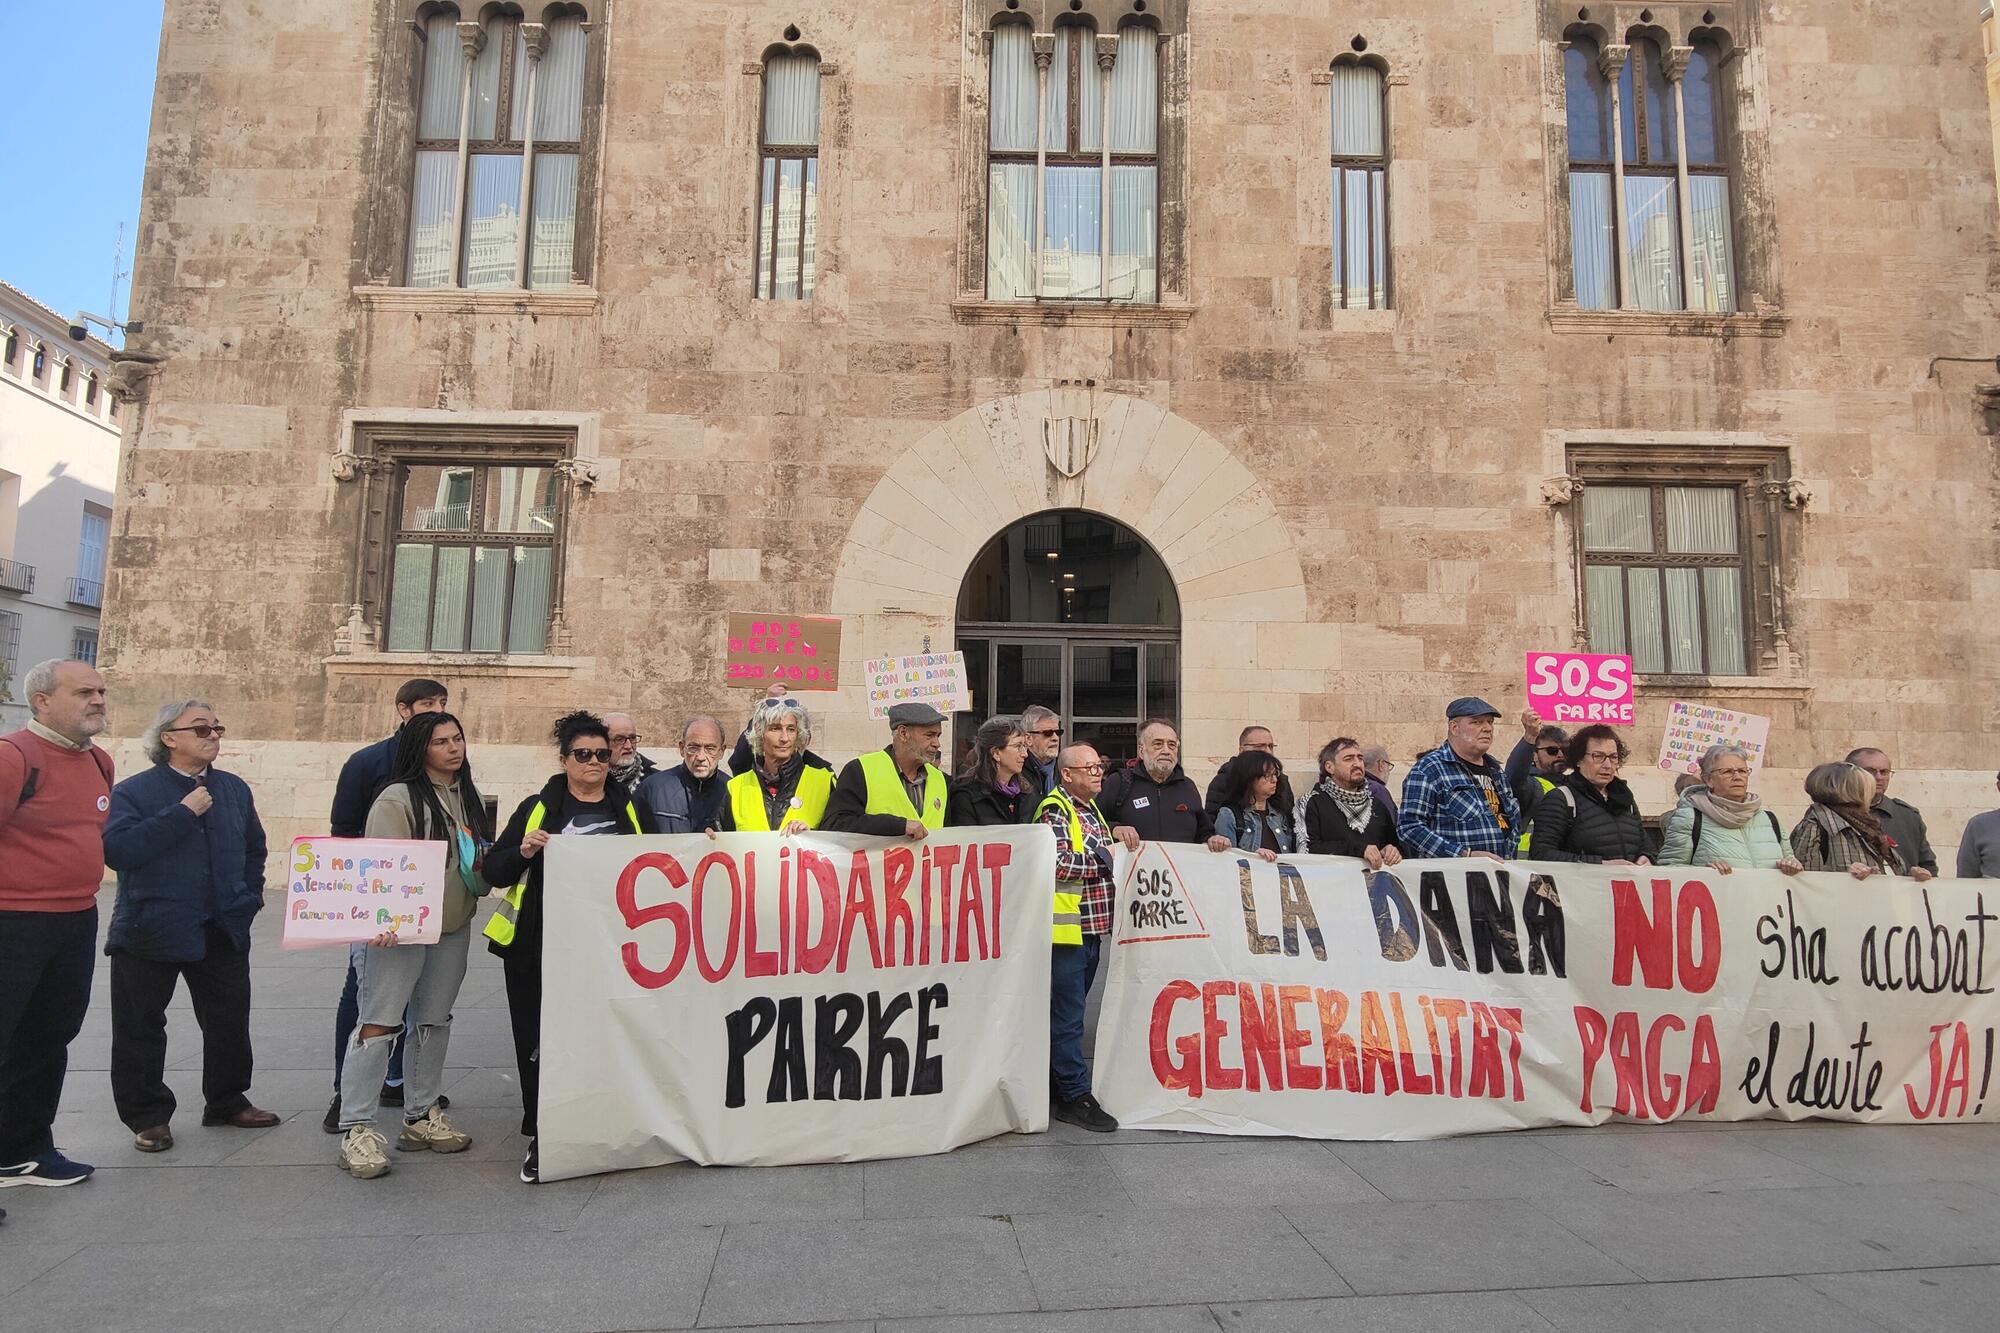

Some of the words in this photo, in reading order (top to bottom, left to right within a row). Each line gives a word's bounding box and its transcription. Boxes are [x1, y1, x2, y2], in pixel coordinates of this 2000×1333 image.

[868, 656, 896, 673] NOS
[875, 674, 898, 686] CON
[905, 671, 919, 682] LA
[871, 690, 889, 701] CON
[1554, 703, 1633, 721] PARKE
[1674, 703, 1734, 721] PREGUNTAD
[294, 843, 320, 872] Si
[332, 857, 353, 871] no
[359, 857, 394, 877] paró
[400, 855, 417, 871] la
[293, 873, 352, 893] atención
[401, 882, 425, 898] qué
[1136, 867, 1173, 898] SOS
[292, 900, 344, 920] Pararon
[351, 905, 370, 920] los
[1129, 899, 1188, 930] PARKE
[1236, 858, 1328, 962] LA
[1362, 868, 1568, 979] DANA
[1611, 878, 1722, 994] NO
[1861, 888, 1999, 995] acabat
[725, 982, 949, 1108] PARKE
[1574, 1005, 1722, 1120] PAGA
[1739, 1021, 1780, 1109] el
[1787, 1021, 1883, 1113] deute
